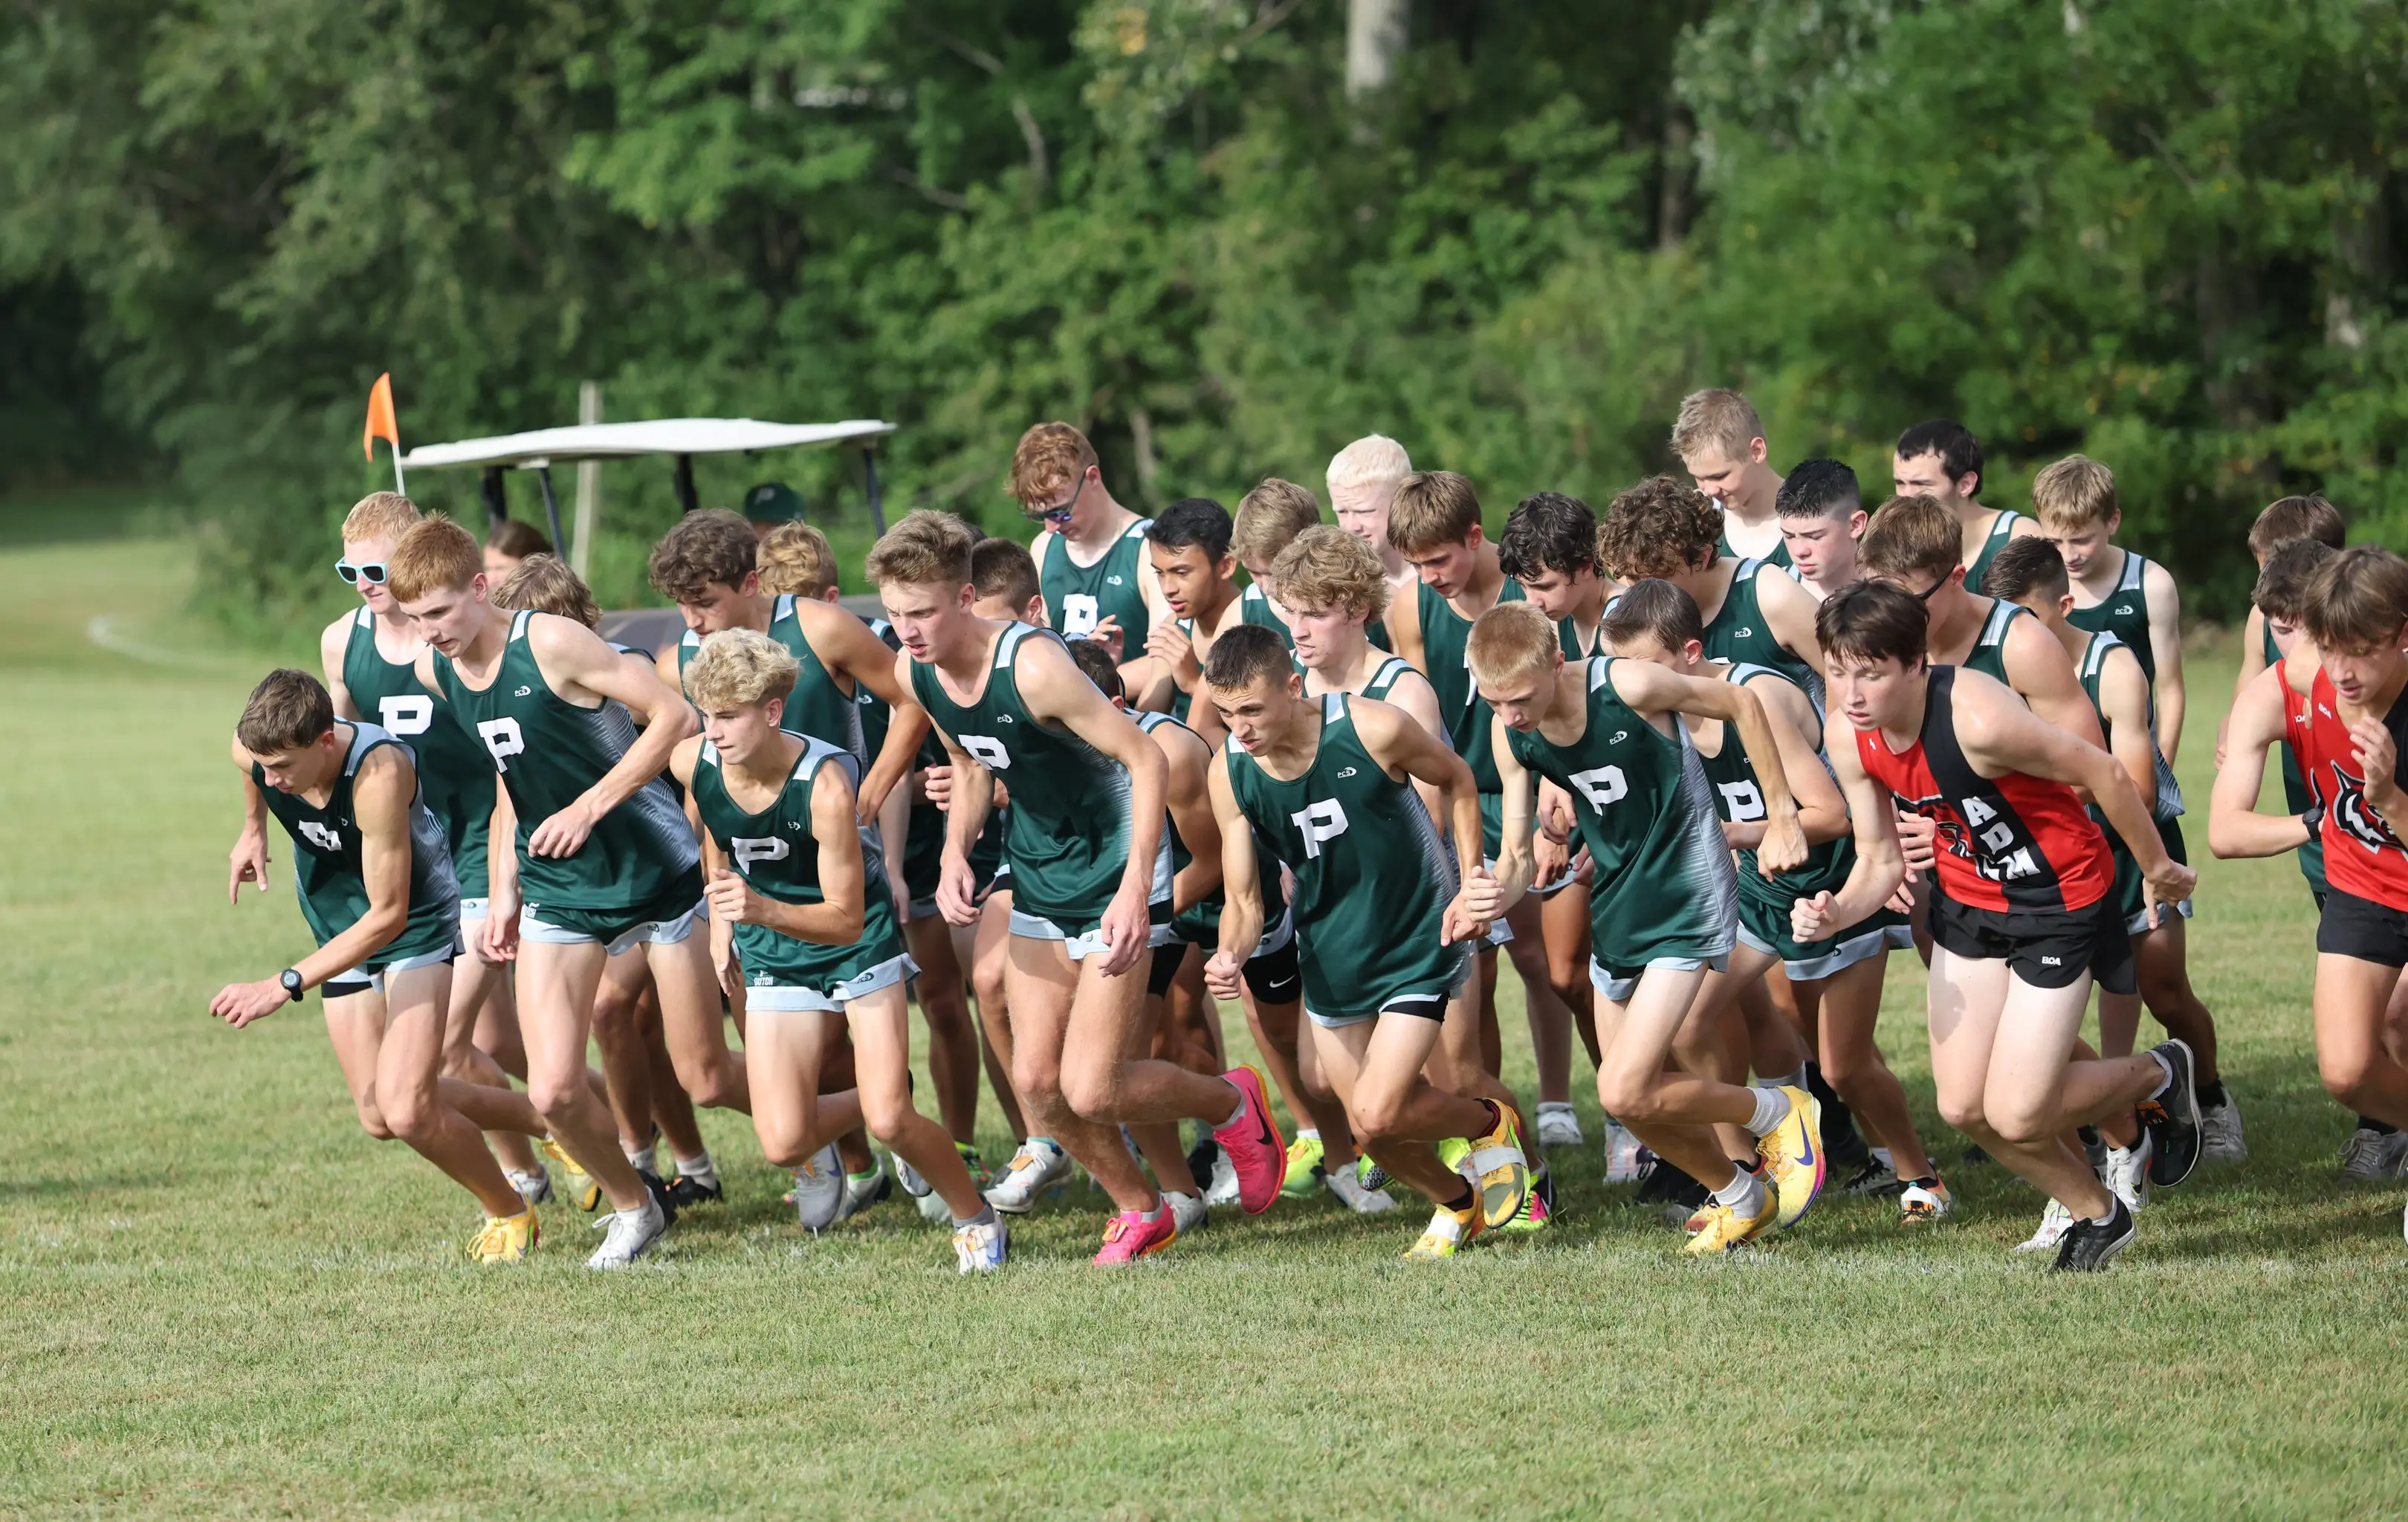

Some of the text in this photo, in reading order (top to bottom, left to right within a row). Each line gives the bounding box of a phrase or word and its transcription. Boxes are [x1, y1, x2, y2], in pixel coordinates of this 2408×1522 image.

[1062, 593, 1098, 635] P
[1735, 628, 1750, 638] PCS
[378, 694, 434, 737] P
[476, 716, 525, 774] P
[957, 734, 1011, 770] P
[1609, 732, 1625, 745] PCS
[1338, 768, 1355, 779] PCS
[1567, 764, 1628, 817] P
[1716, 779, 1765, 822] P
[1290, 797, 1349, 860] P
[731, 836, 789, 875] P
[2042, 956, 2061, 966] BOA
